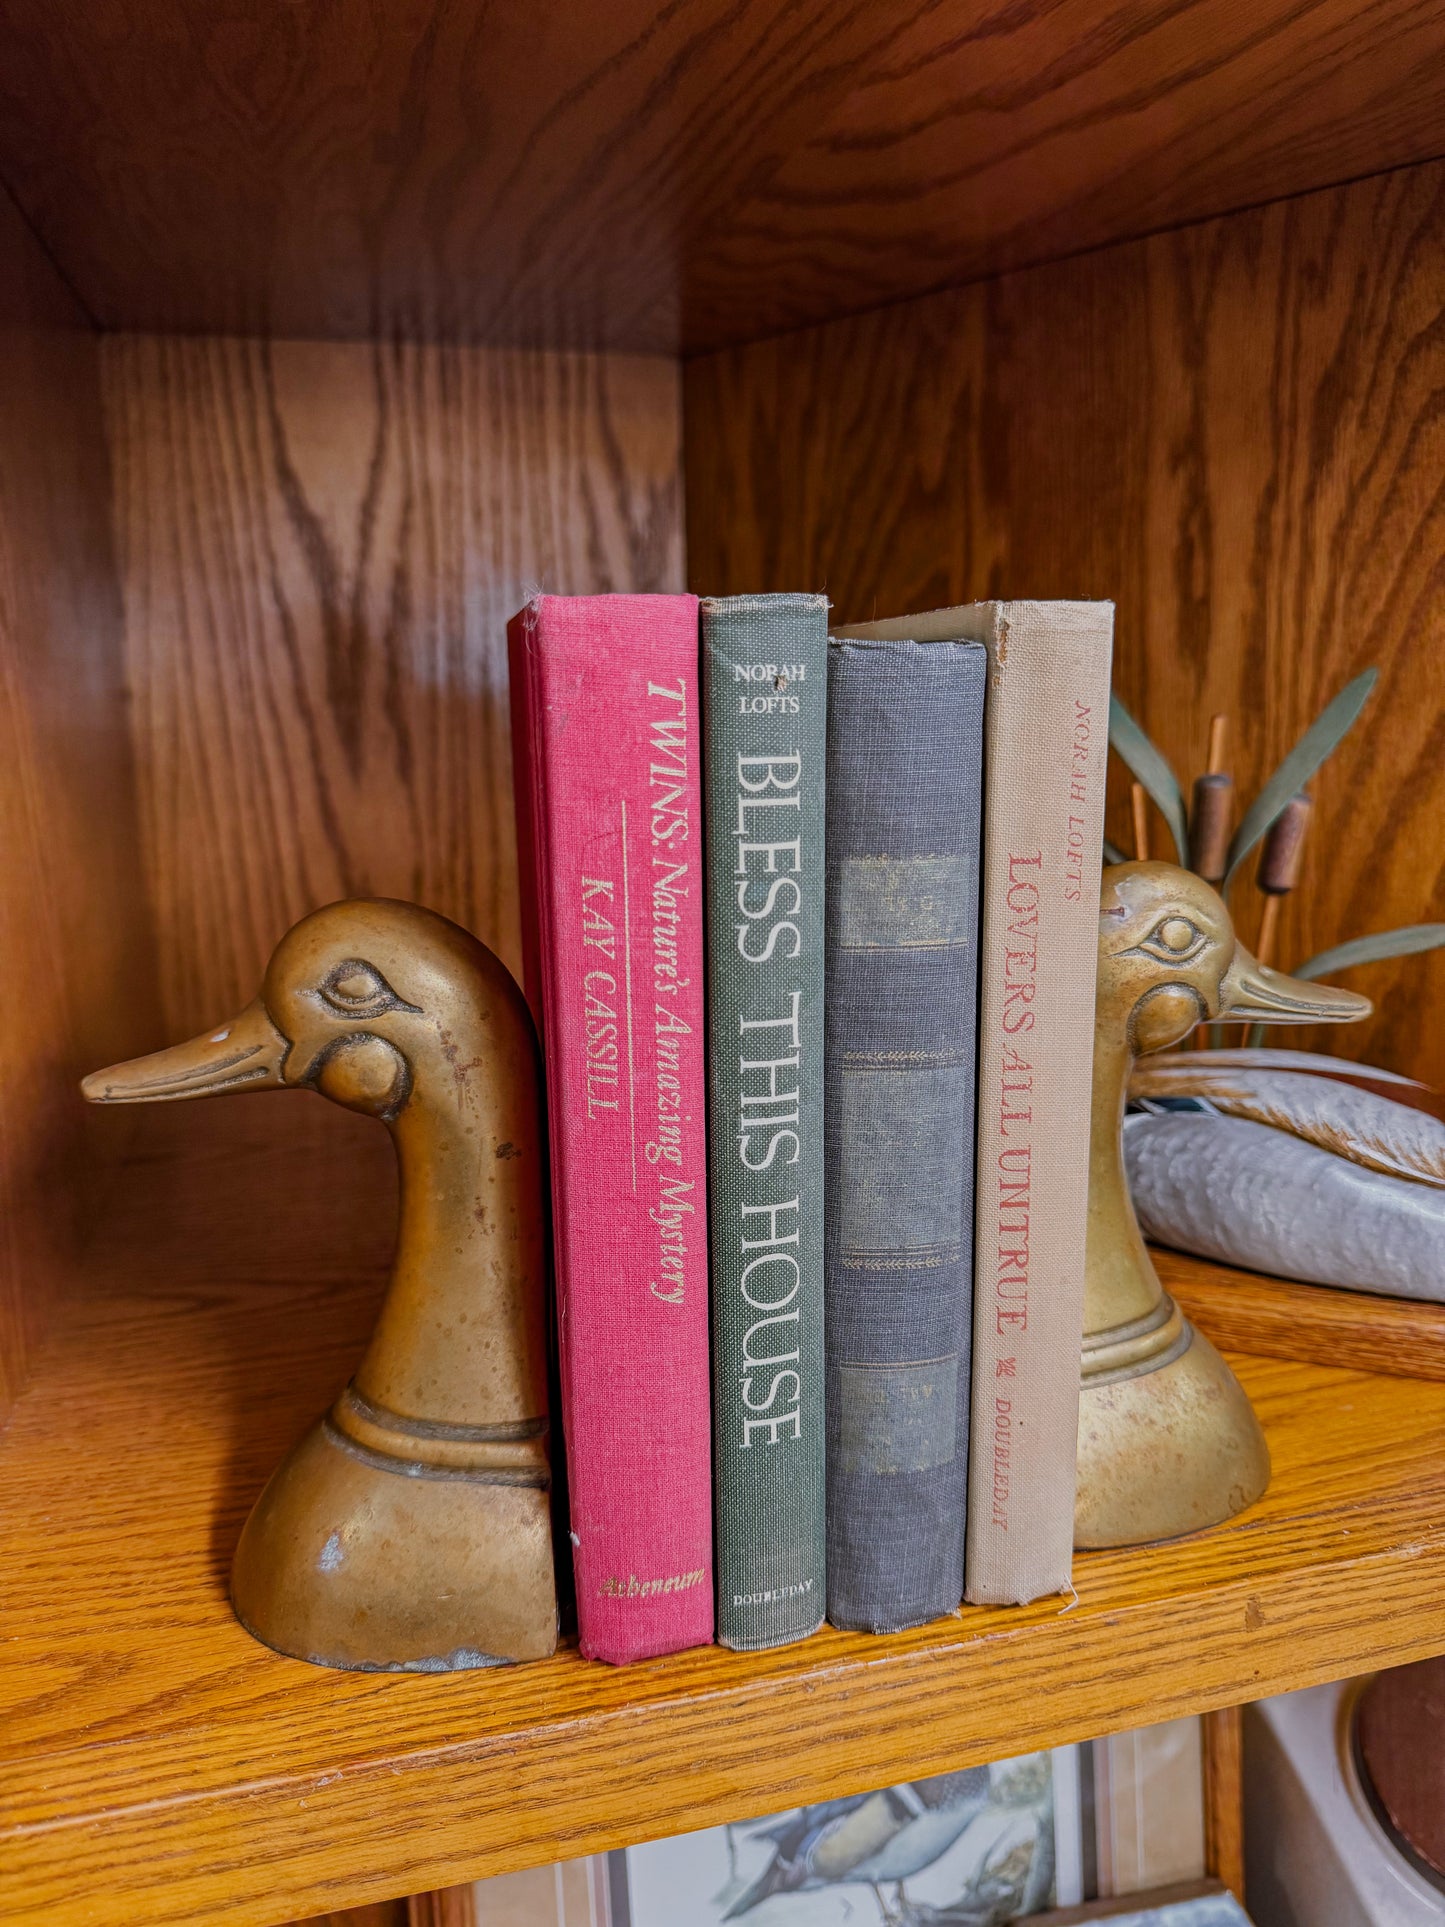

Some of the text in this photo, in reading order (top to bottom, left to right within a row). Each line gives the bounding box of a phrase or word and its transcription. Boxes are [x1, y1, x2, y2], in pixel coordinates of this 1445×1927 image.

[732, 664, 806, 682] NORAH
[740, 696, 800, 714] LOFTS
[1064, 815, 1085, 902] LOFTS
[582, 875, 620, 1121] KAY CASSILL
[645, 677, 695, 1304] TWINS: Nature's Amazing Mystery
[731, 749, 802, 1448] BLESS THIS HOUSE
[996, 850, 1042, 1335] LOVERS ALL UNTRUE
[992, 1397, 1012, 1532] DOUBLEDAY
[597, 1567, 705, 1599] Atheneum
[733, 1578, 814, 1606] DOUBLEDAY
